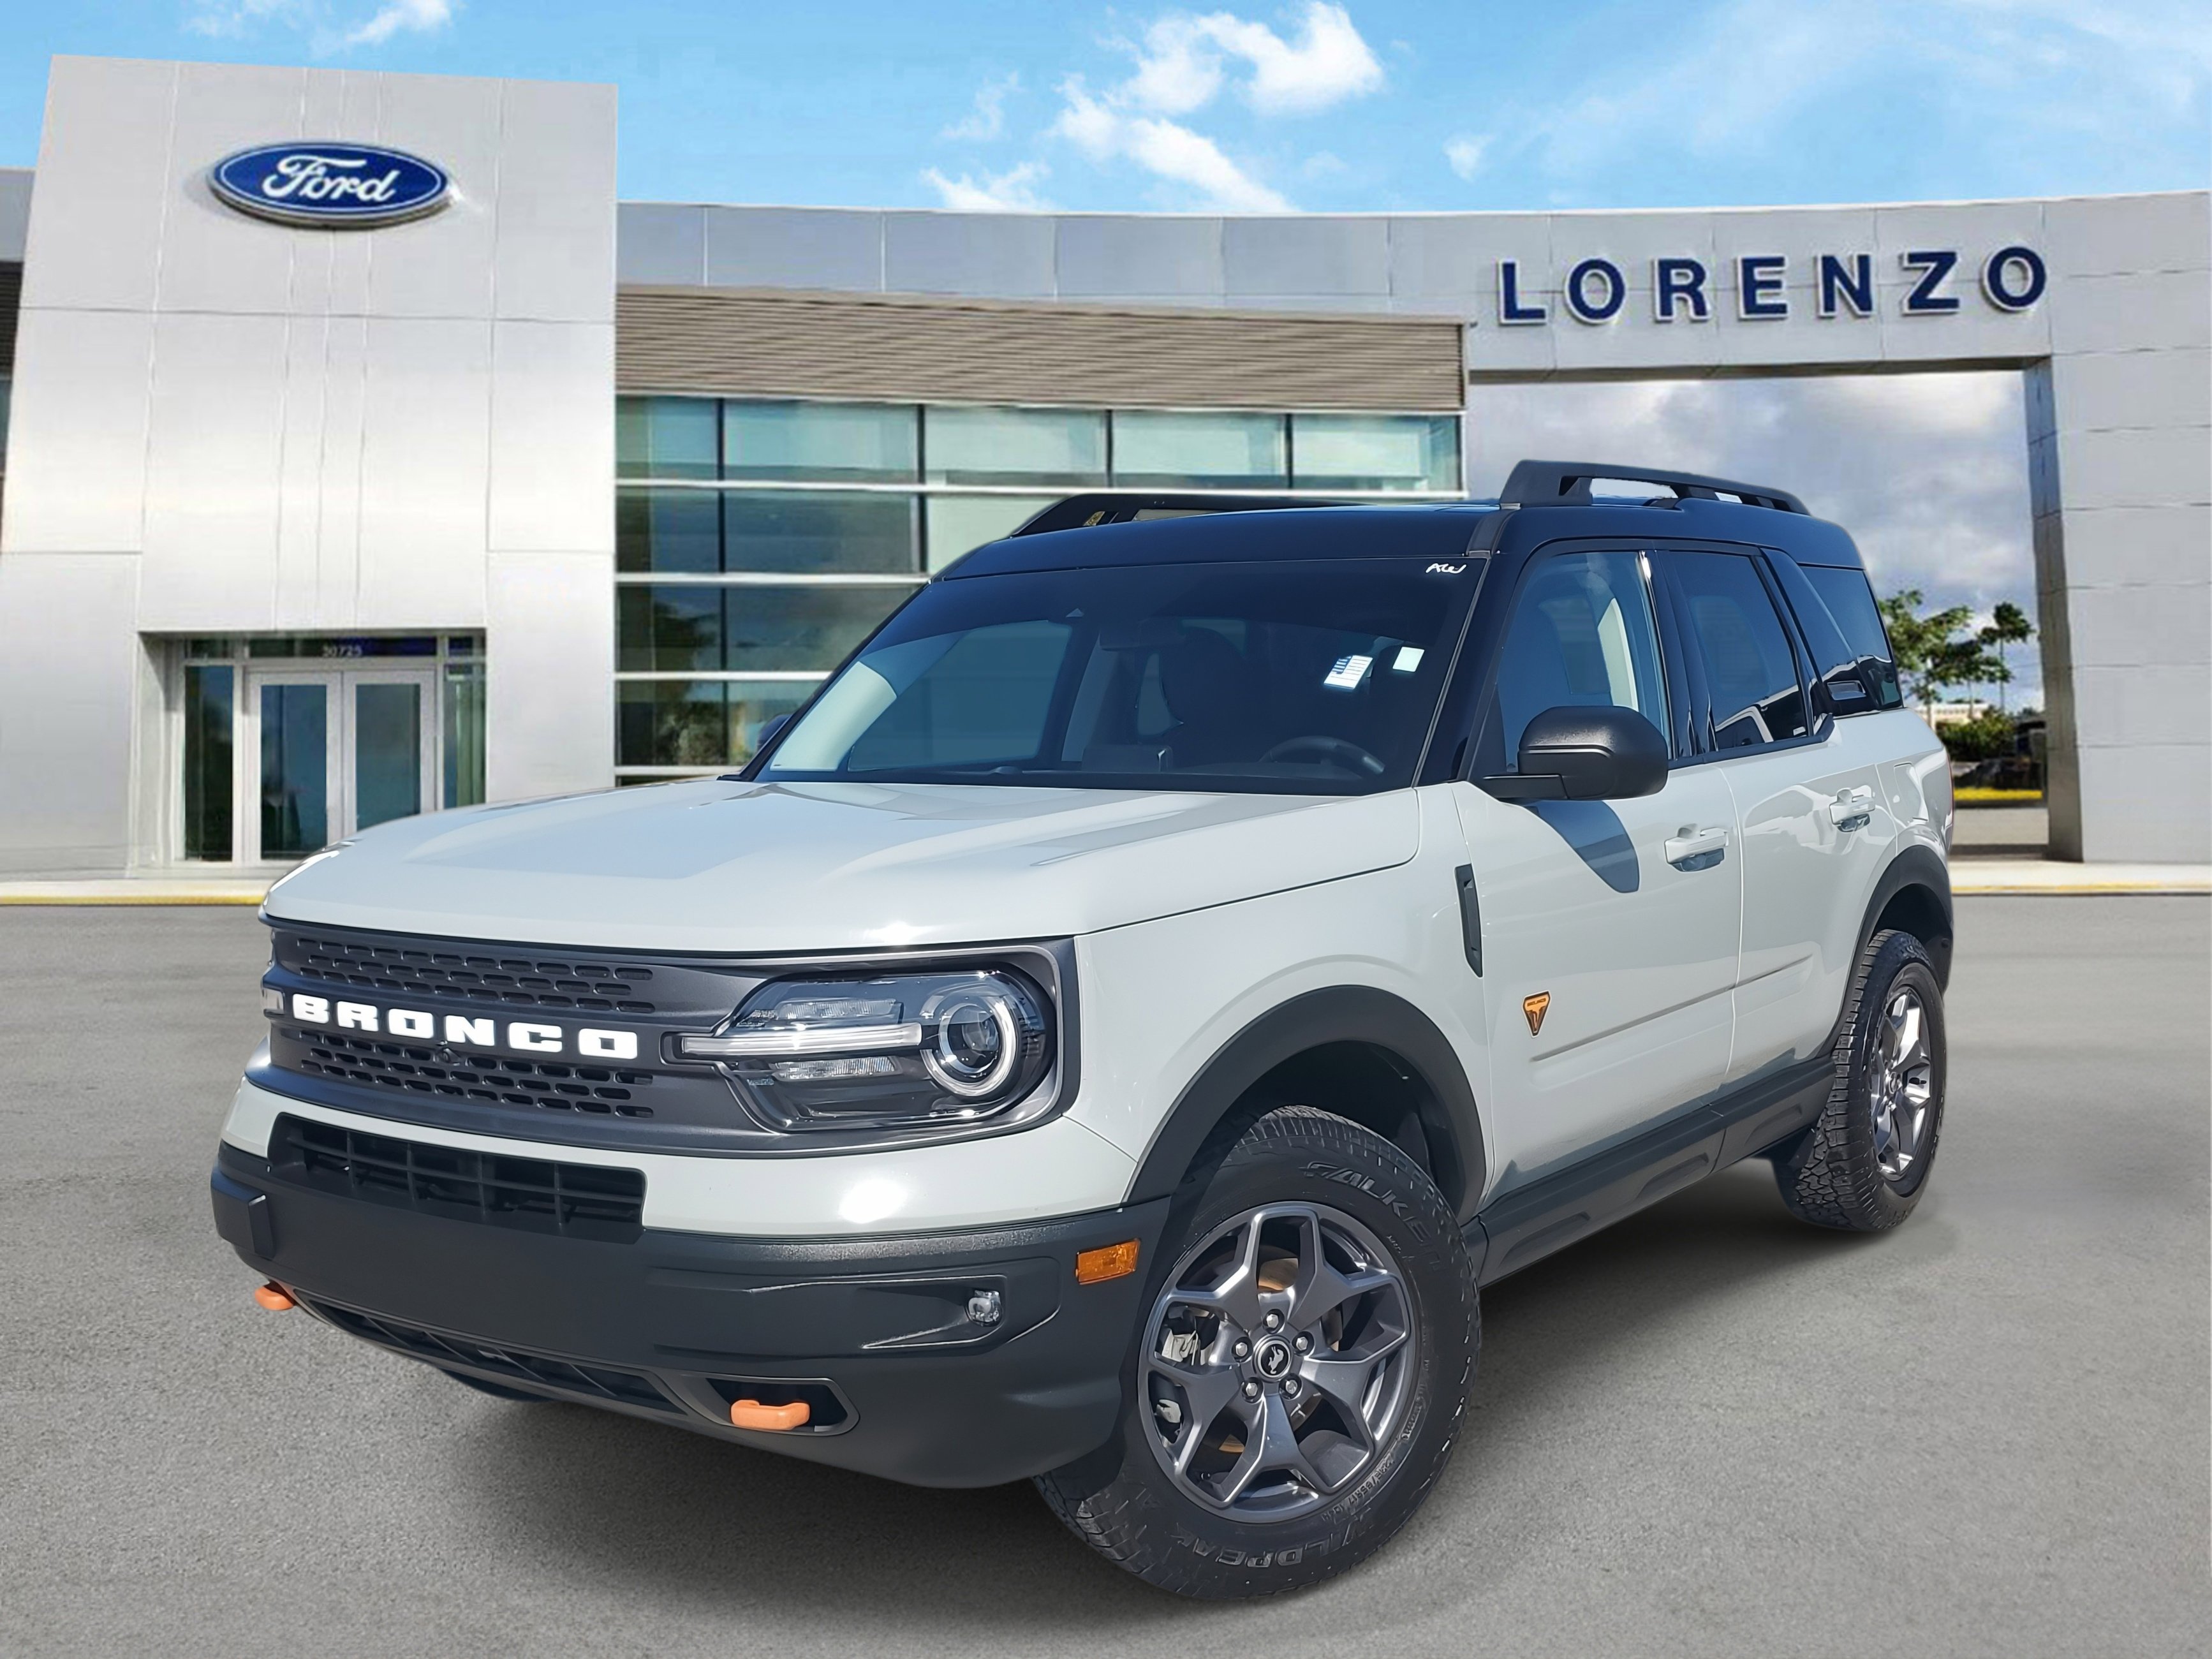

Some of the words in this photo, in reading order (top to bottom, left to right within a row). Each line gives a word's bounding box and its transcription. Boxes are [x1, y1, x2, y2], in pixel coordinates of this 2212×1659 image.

[262, 154, 401, 202] Ford
[1497, 246, 2046, 324] LORENZO
[292, 993, 638, 1059] BRONCO
[1299, 1161, 1444, 1271] FALKEN
[1170, 1507, 1375, 1568] WILDPEAK
